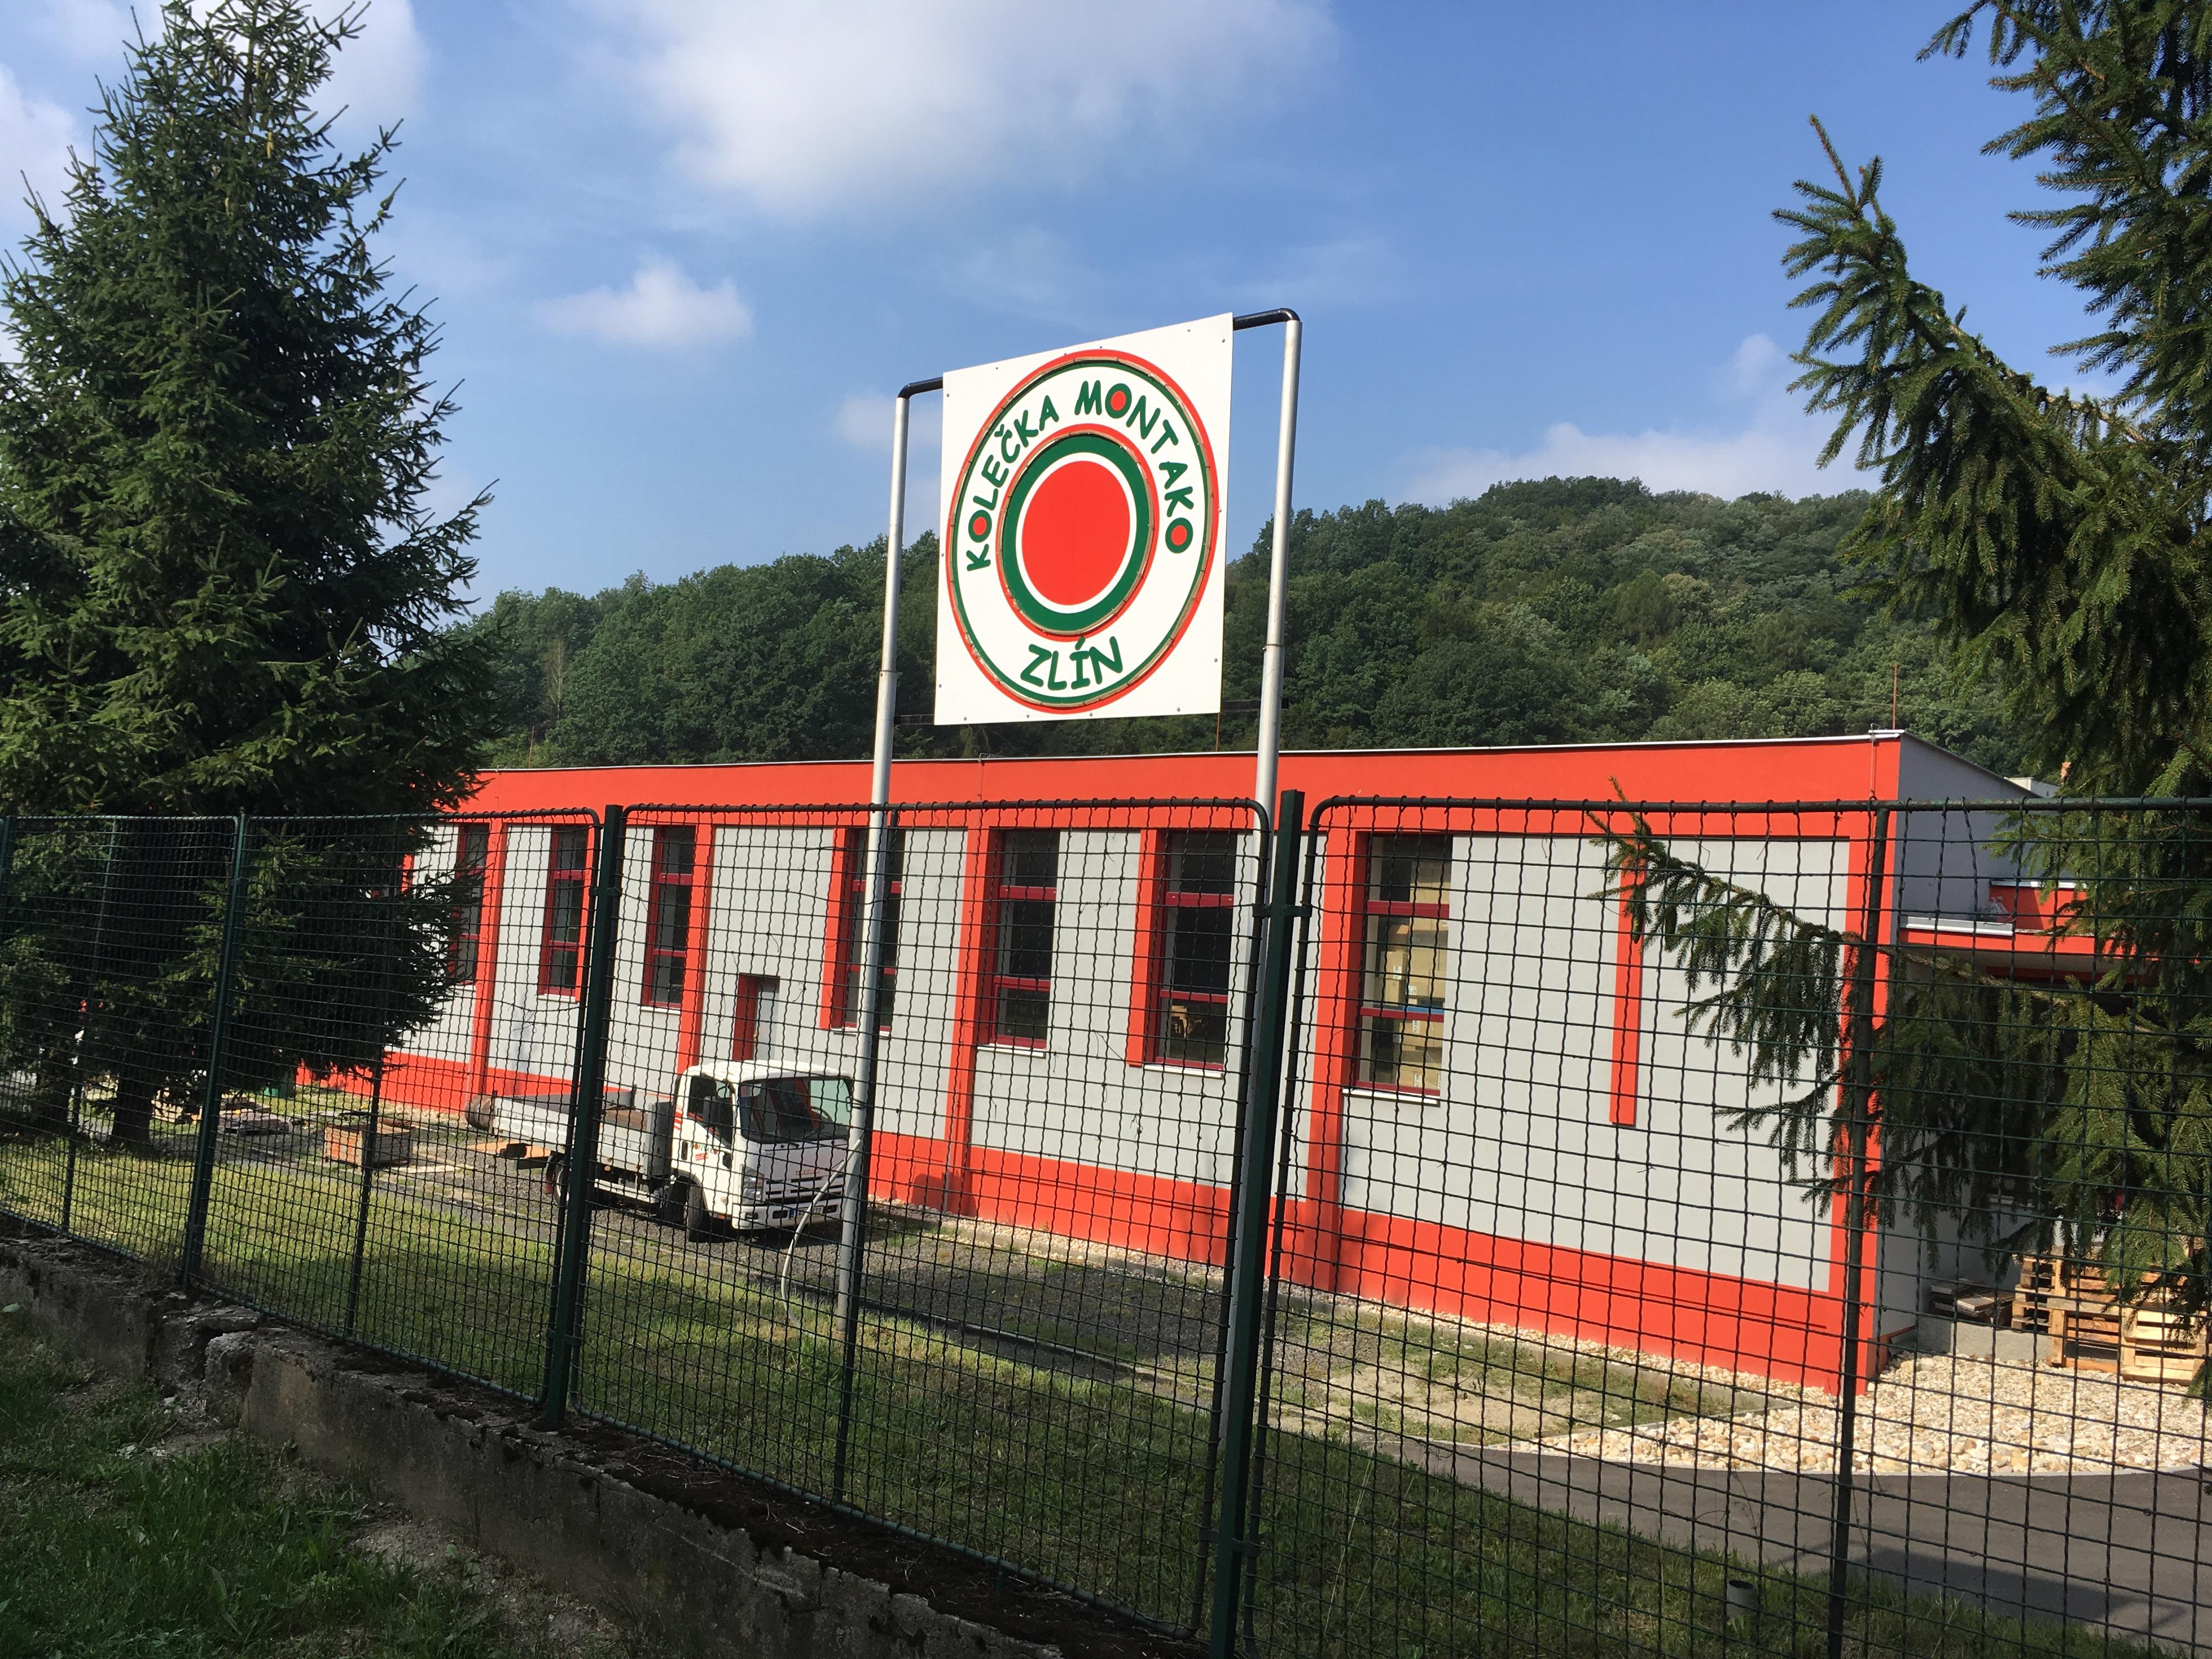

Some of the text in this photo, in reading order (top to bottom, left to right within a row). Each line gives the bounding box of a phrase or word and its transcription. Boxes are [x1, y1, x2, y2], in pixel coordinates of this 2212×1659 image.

[966, 380, 1193, 571] KOLEČKA MONTAKO
[1021, 636, 1123, 690] ZLÍN
